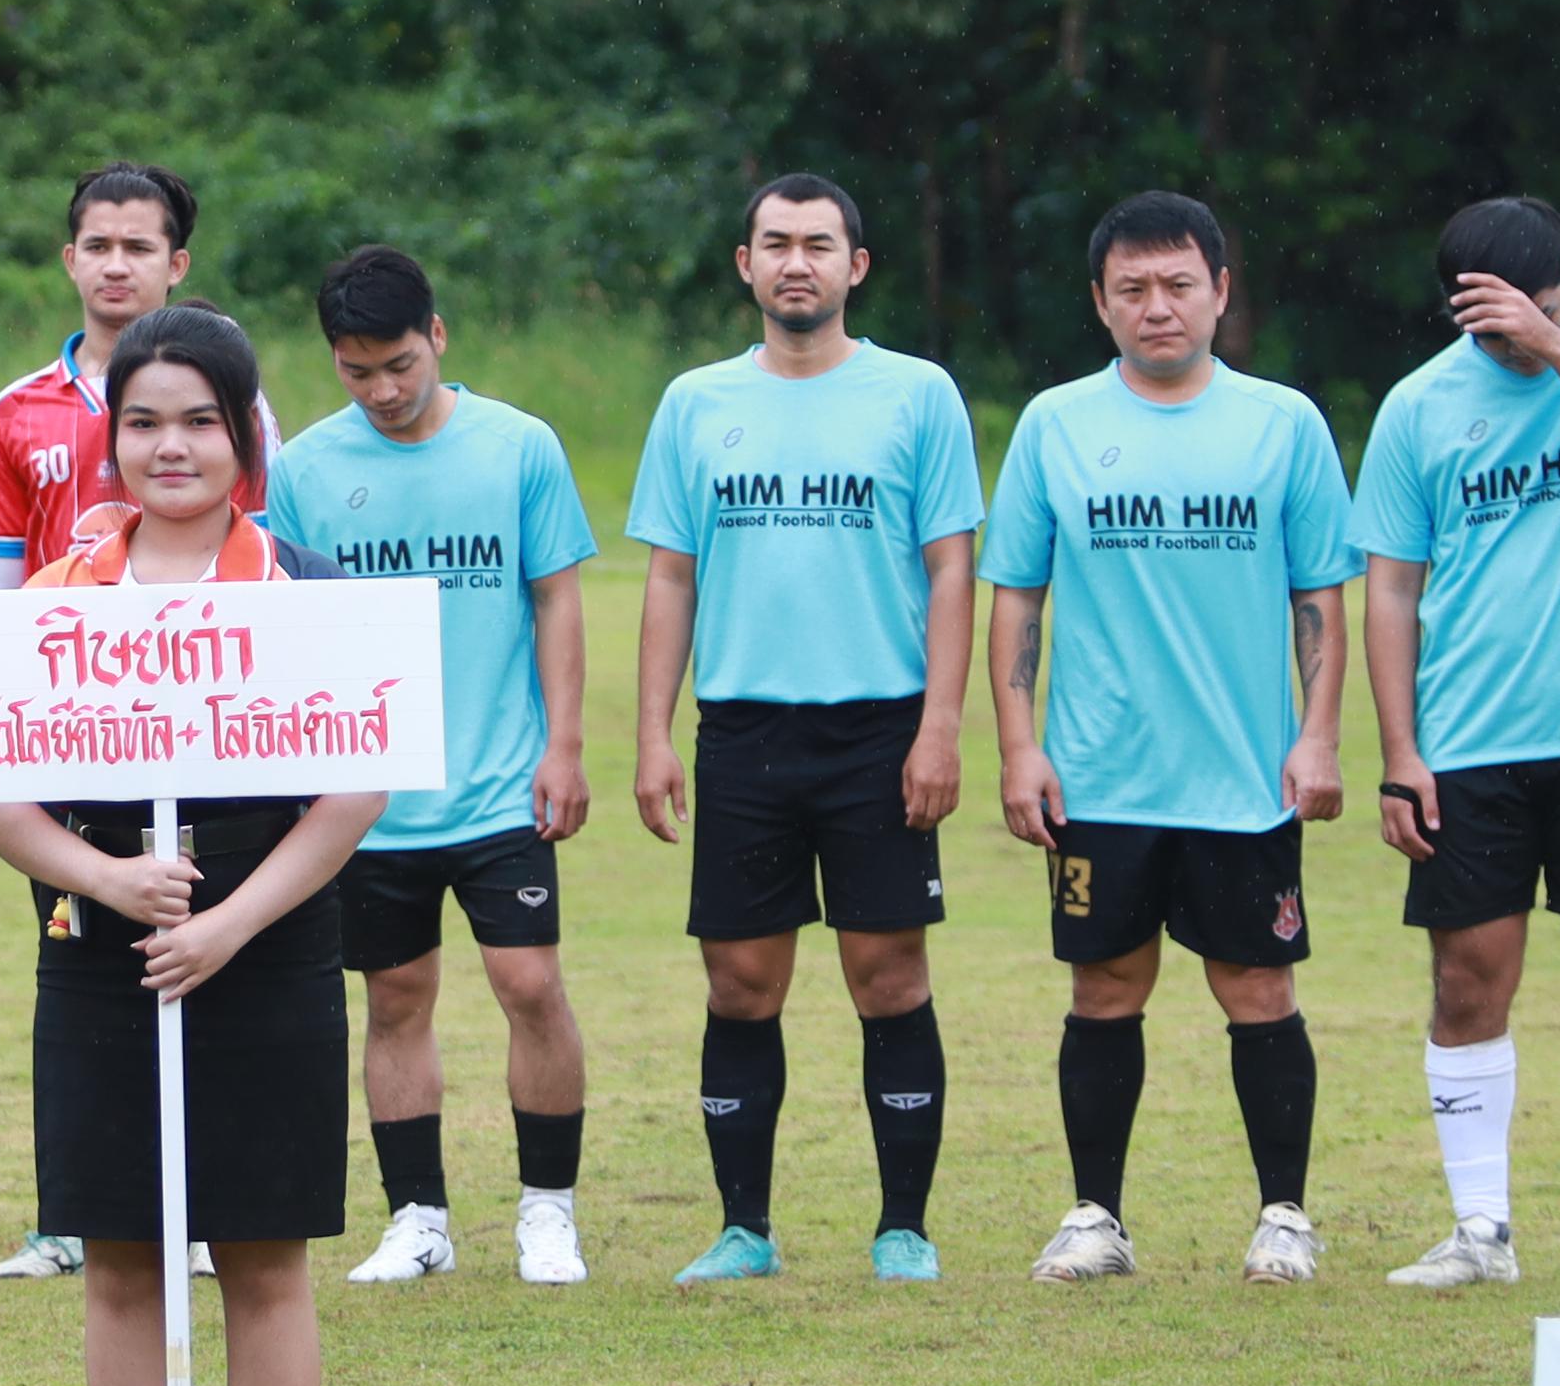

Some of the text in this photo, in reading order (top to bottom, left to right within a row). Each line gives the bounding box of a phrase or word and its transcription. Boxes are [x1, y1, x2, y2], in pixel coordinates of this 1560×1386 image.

[31, 442, 71, 490] 30
[713, 473, 875, 510] HIM HIM
[773, 513, 835, 527] Football
[840, 514, 873, 530] Club
[1087, 494, 1258, 531] HIM HIM
[1465, 508, 1510, 528] Maeso
[337, 534, 503, 575] HIM HIM
[1090, 534, 1256, 552] Maesod Football Club
[469, 574, 502, 589] Club
[34, 593, 256, 690] ศิษย์เก่า
